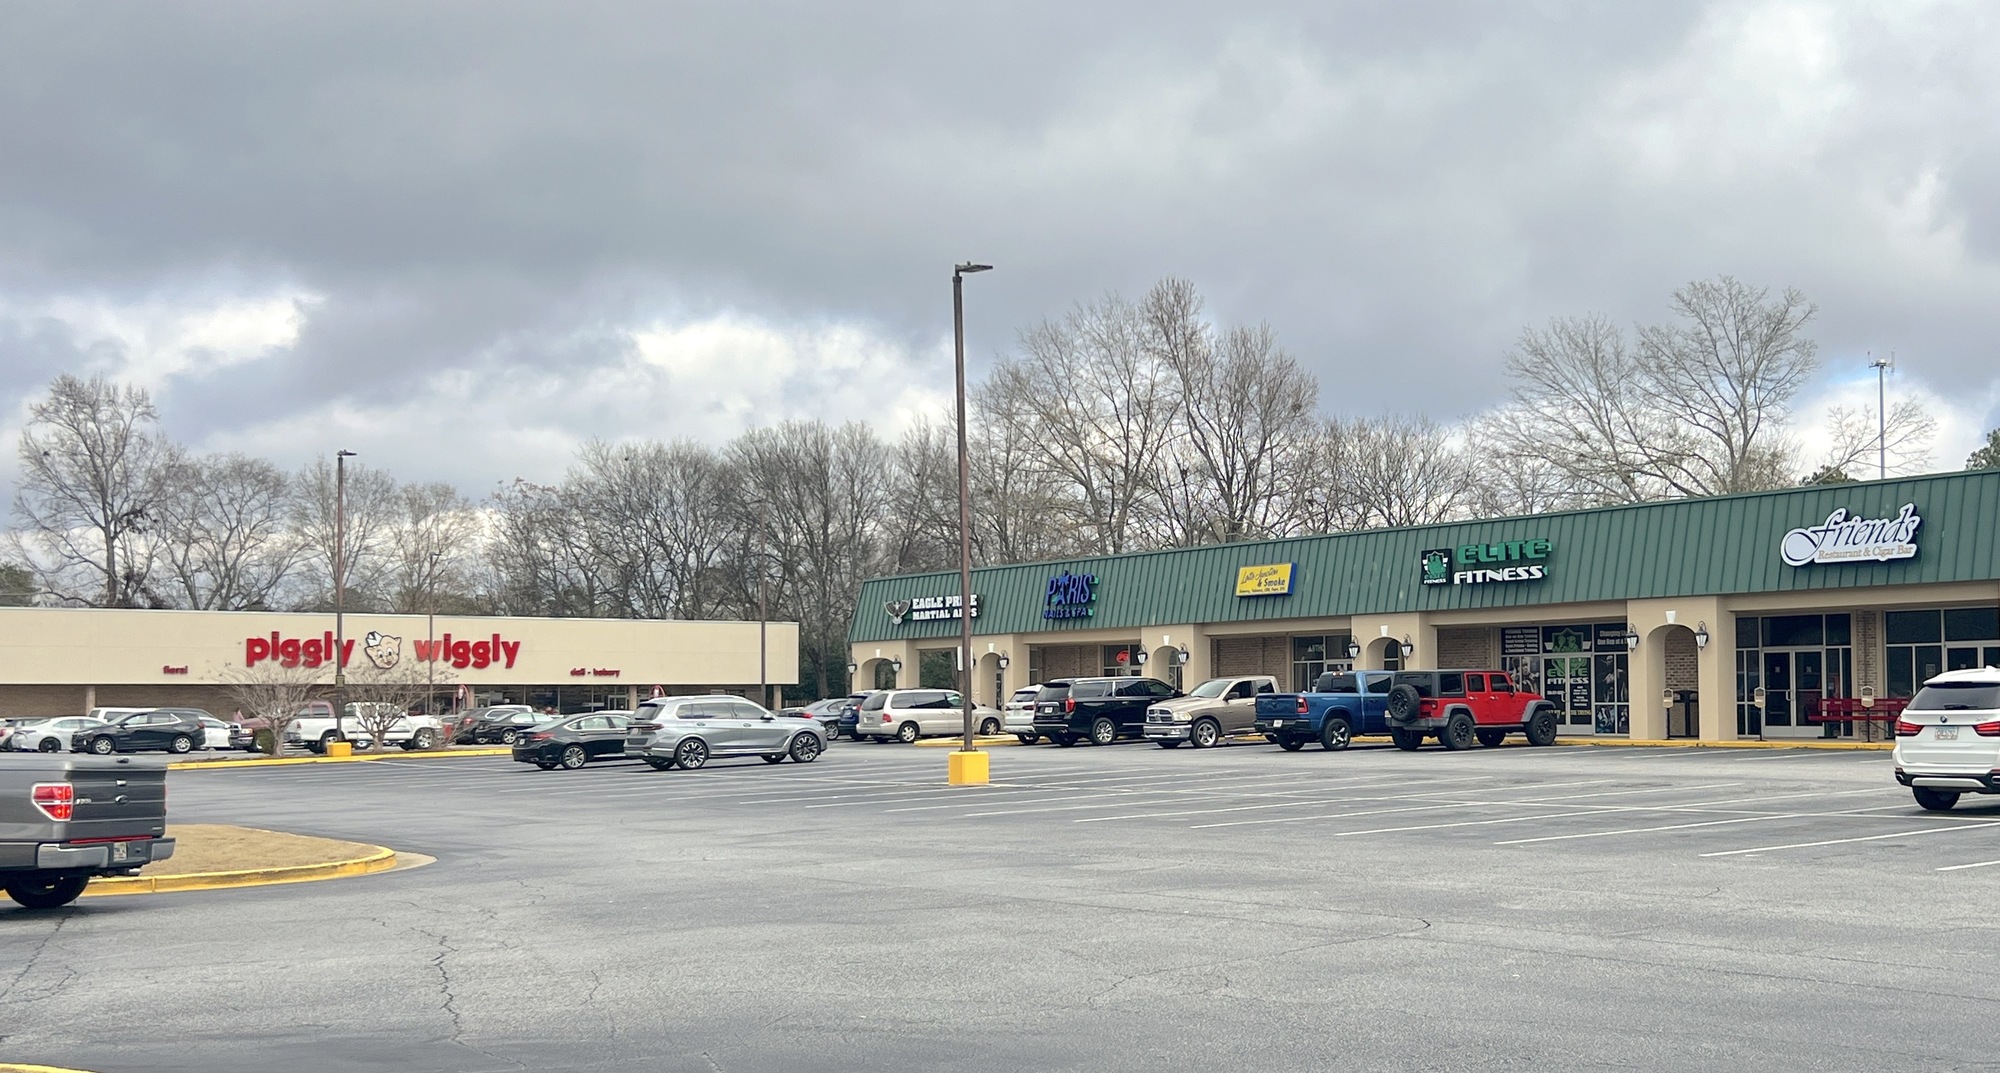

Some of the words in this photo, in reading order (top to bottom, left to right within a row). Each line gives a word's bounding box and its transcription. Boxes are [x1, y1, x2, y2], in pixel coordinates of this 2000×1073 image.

[1457, 538, 1548, 564] ELITE
[1818, 549, 1861, 560] Restaurant
[1863, 547, 1871, 557] &
[1872, 546, 1895, 558] Cigar
[1897, 544, 1913, 555] Bar
[1264, 577, 1286, 587] Smoke
[1454, 565, 1543, 585] FITNESS
[1045, 570, 1094, 606] PARIS
[913, 596, 944, 609] EAGLE
[945, 594, 978, 607] PRIE
[913, 609, 950, 620] MARTIAL
[953, 607, 978, 619] AS
[246, 631, 356, 668] piggly
[413, 633, 521, 669] wiggly
[1547, 668, 1588, 678] ELTE
[1547, 677, 1589, 685] FITESS
